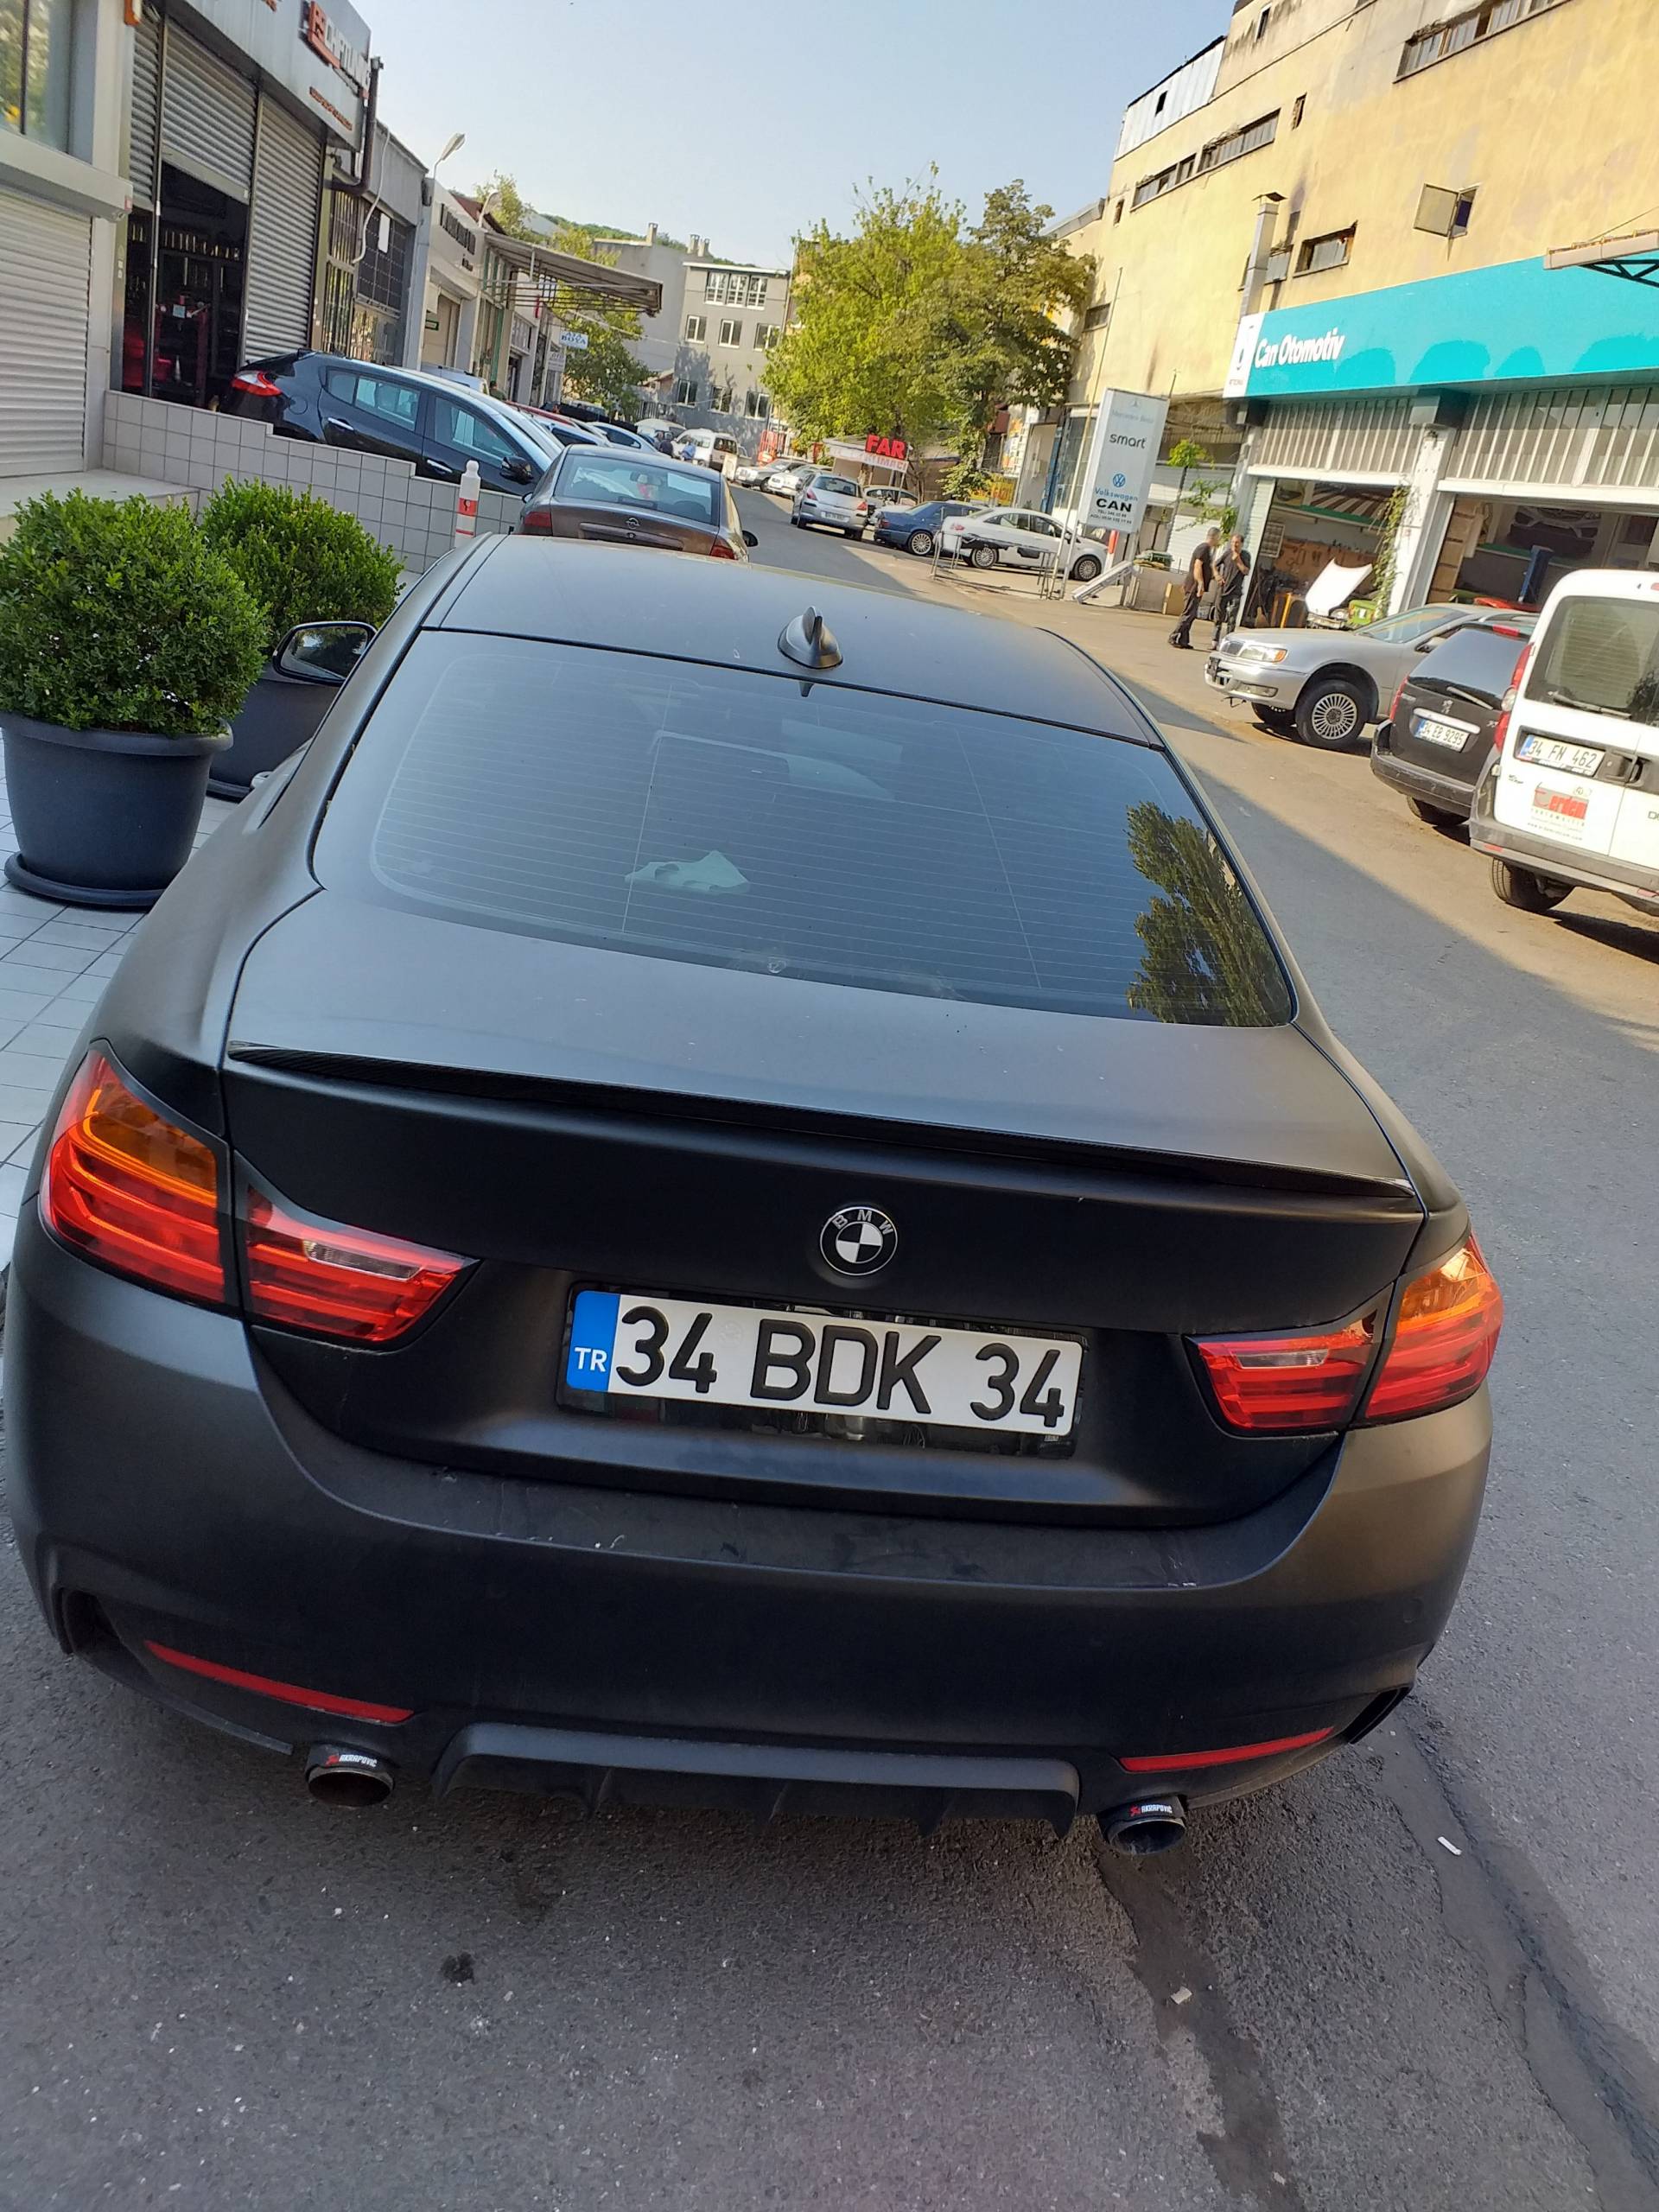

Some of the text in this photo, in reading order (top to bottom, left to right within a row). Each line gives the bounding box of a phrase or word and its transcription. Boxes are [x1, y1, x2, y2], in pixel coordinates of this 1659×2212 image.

[1255, 327, 1345, 368] Can Otomotiv
[866, 434, 906, 459] FAR
[1109, 433, 1147, 449] smart
[1095, 487, 1139, 501] Volkswagen
[1096, 498, 1132, 512] CAN
[1443, 728, 1464, 746] 9295
[1528, 740, 1544, 755] 34
[1548, 744, 1567, 760] FN
[1572, 750, 1598, 768] 462
[832, 1207, 894, 1236] BMW
[574, 1346, 607, 1372] TR
[616, 1306, 1065, 1428] 34 BDK 34
